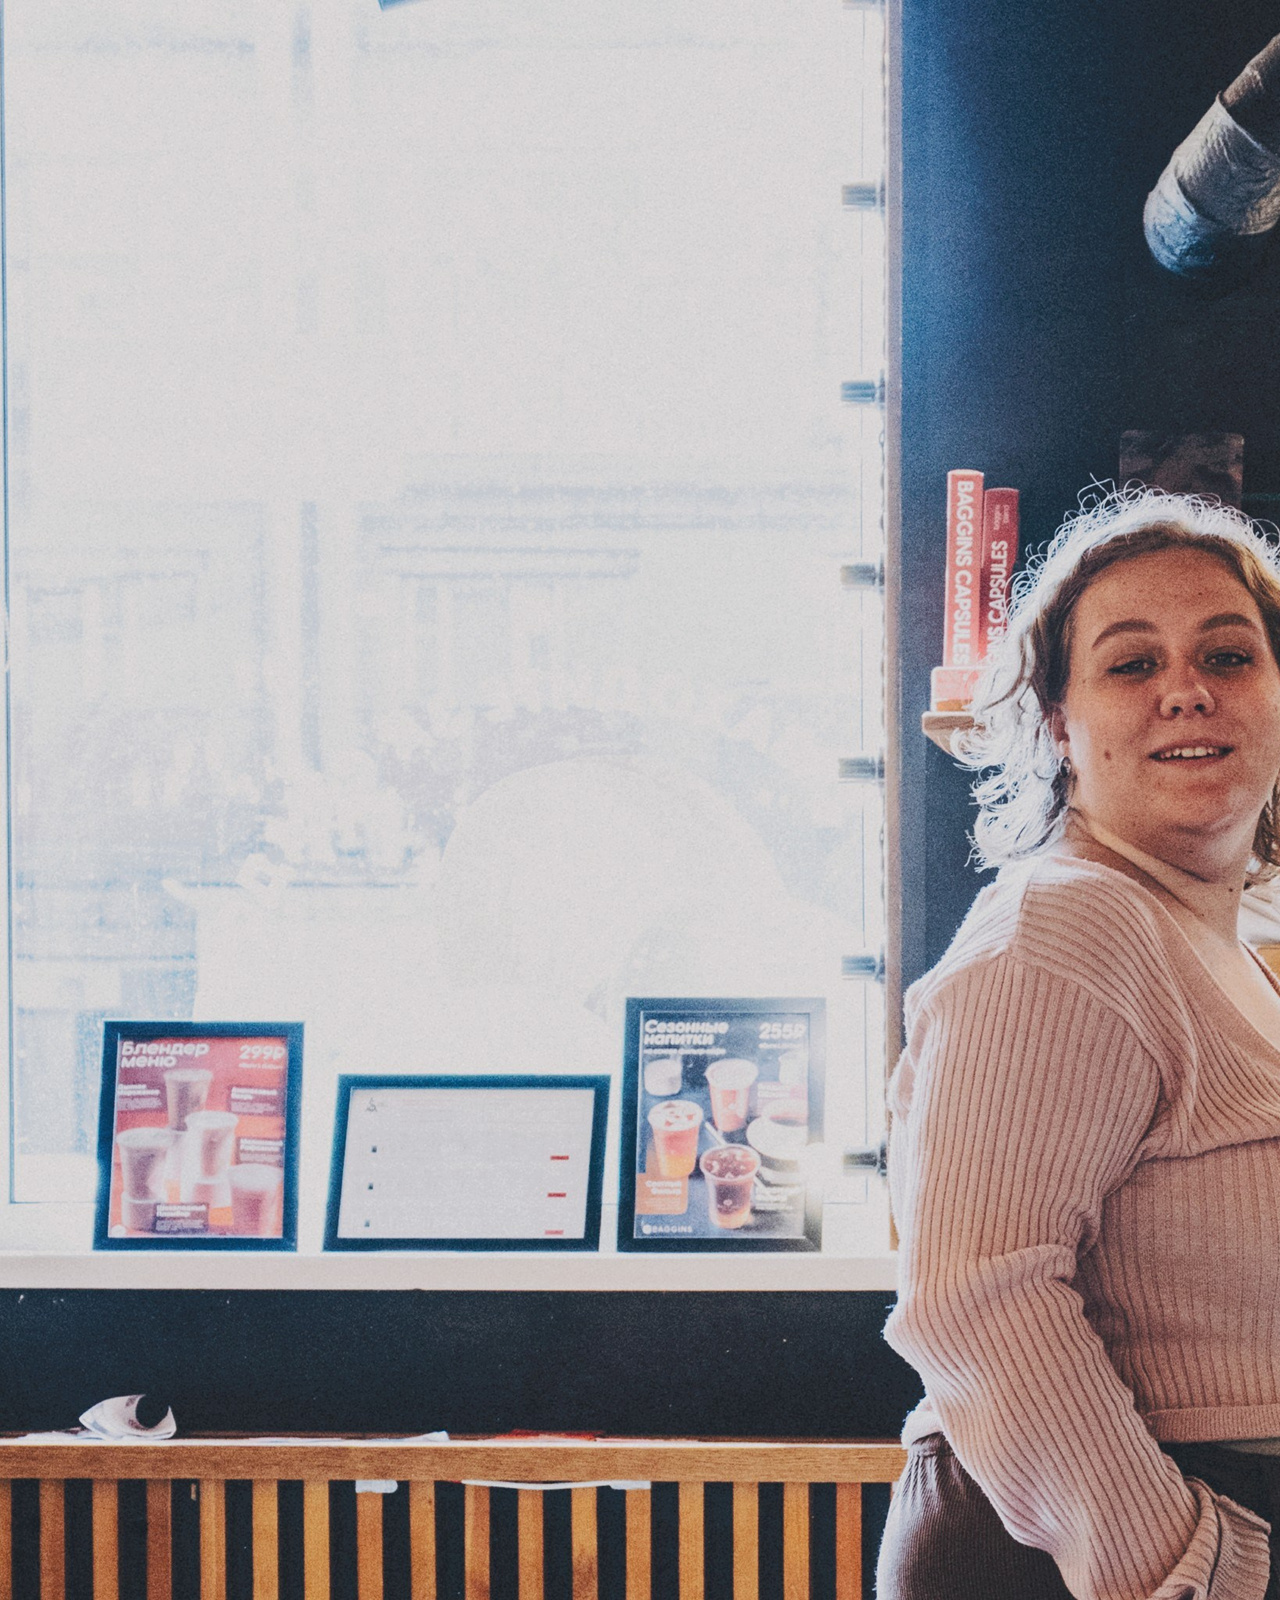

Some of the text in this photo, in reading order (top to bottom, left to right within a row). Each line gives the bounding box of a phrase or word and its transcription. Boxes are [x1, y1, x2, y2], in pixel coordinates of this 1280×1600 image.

[952, 481, 974, 666] BAGGINS CAPSULES
[988, 540, 1008, 621] CAPSULES
[644, 1019, 730, 1035] Сезонные
[643, 1033, 715, 1046] напитки
[121, 1041, 210, 1057] Блендер
[120, 1056, 178, 1069] меню
